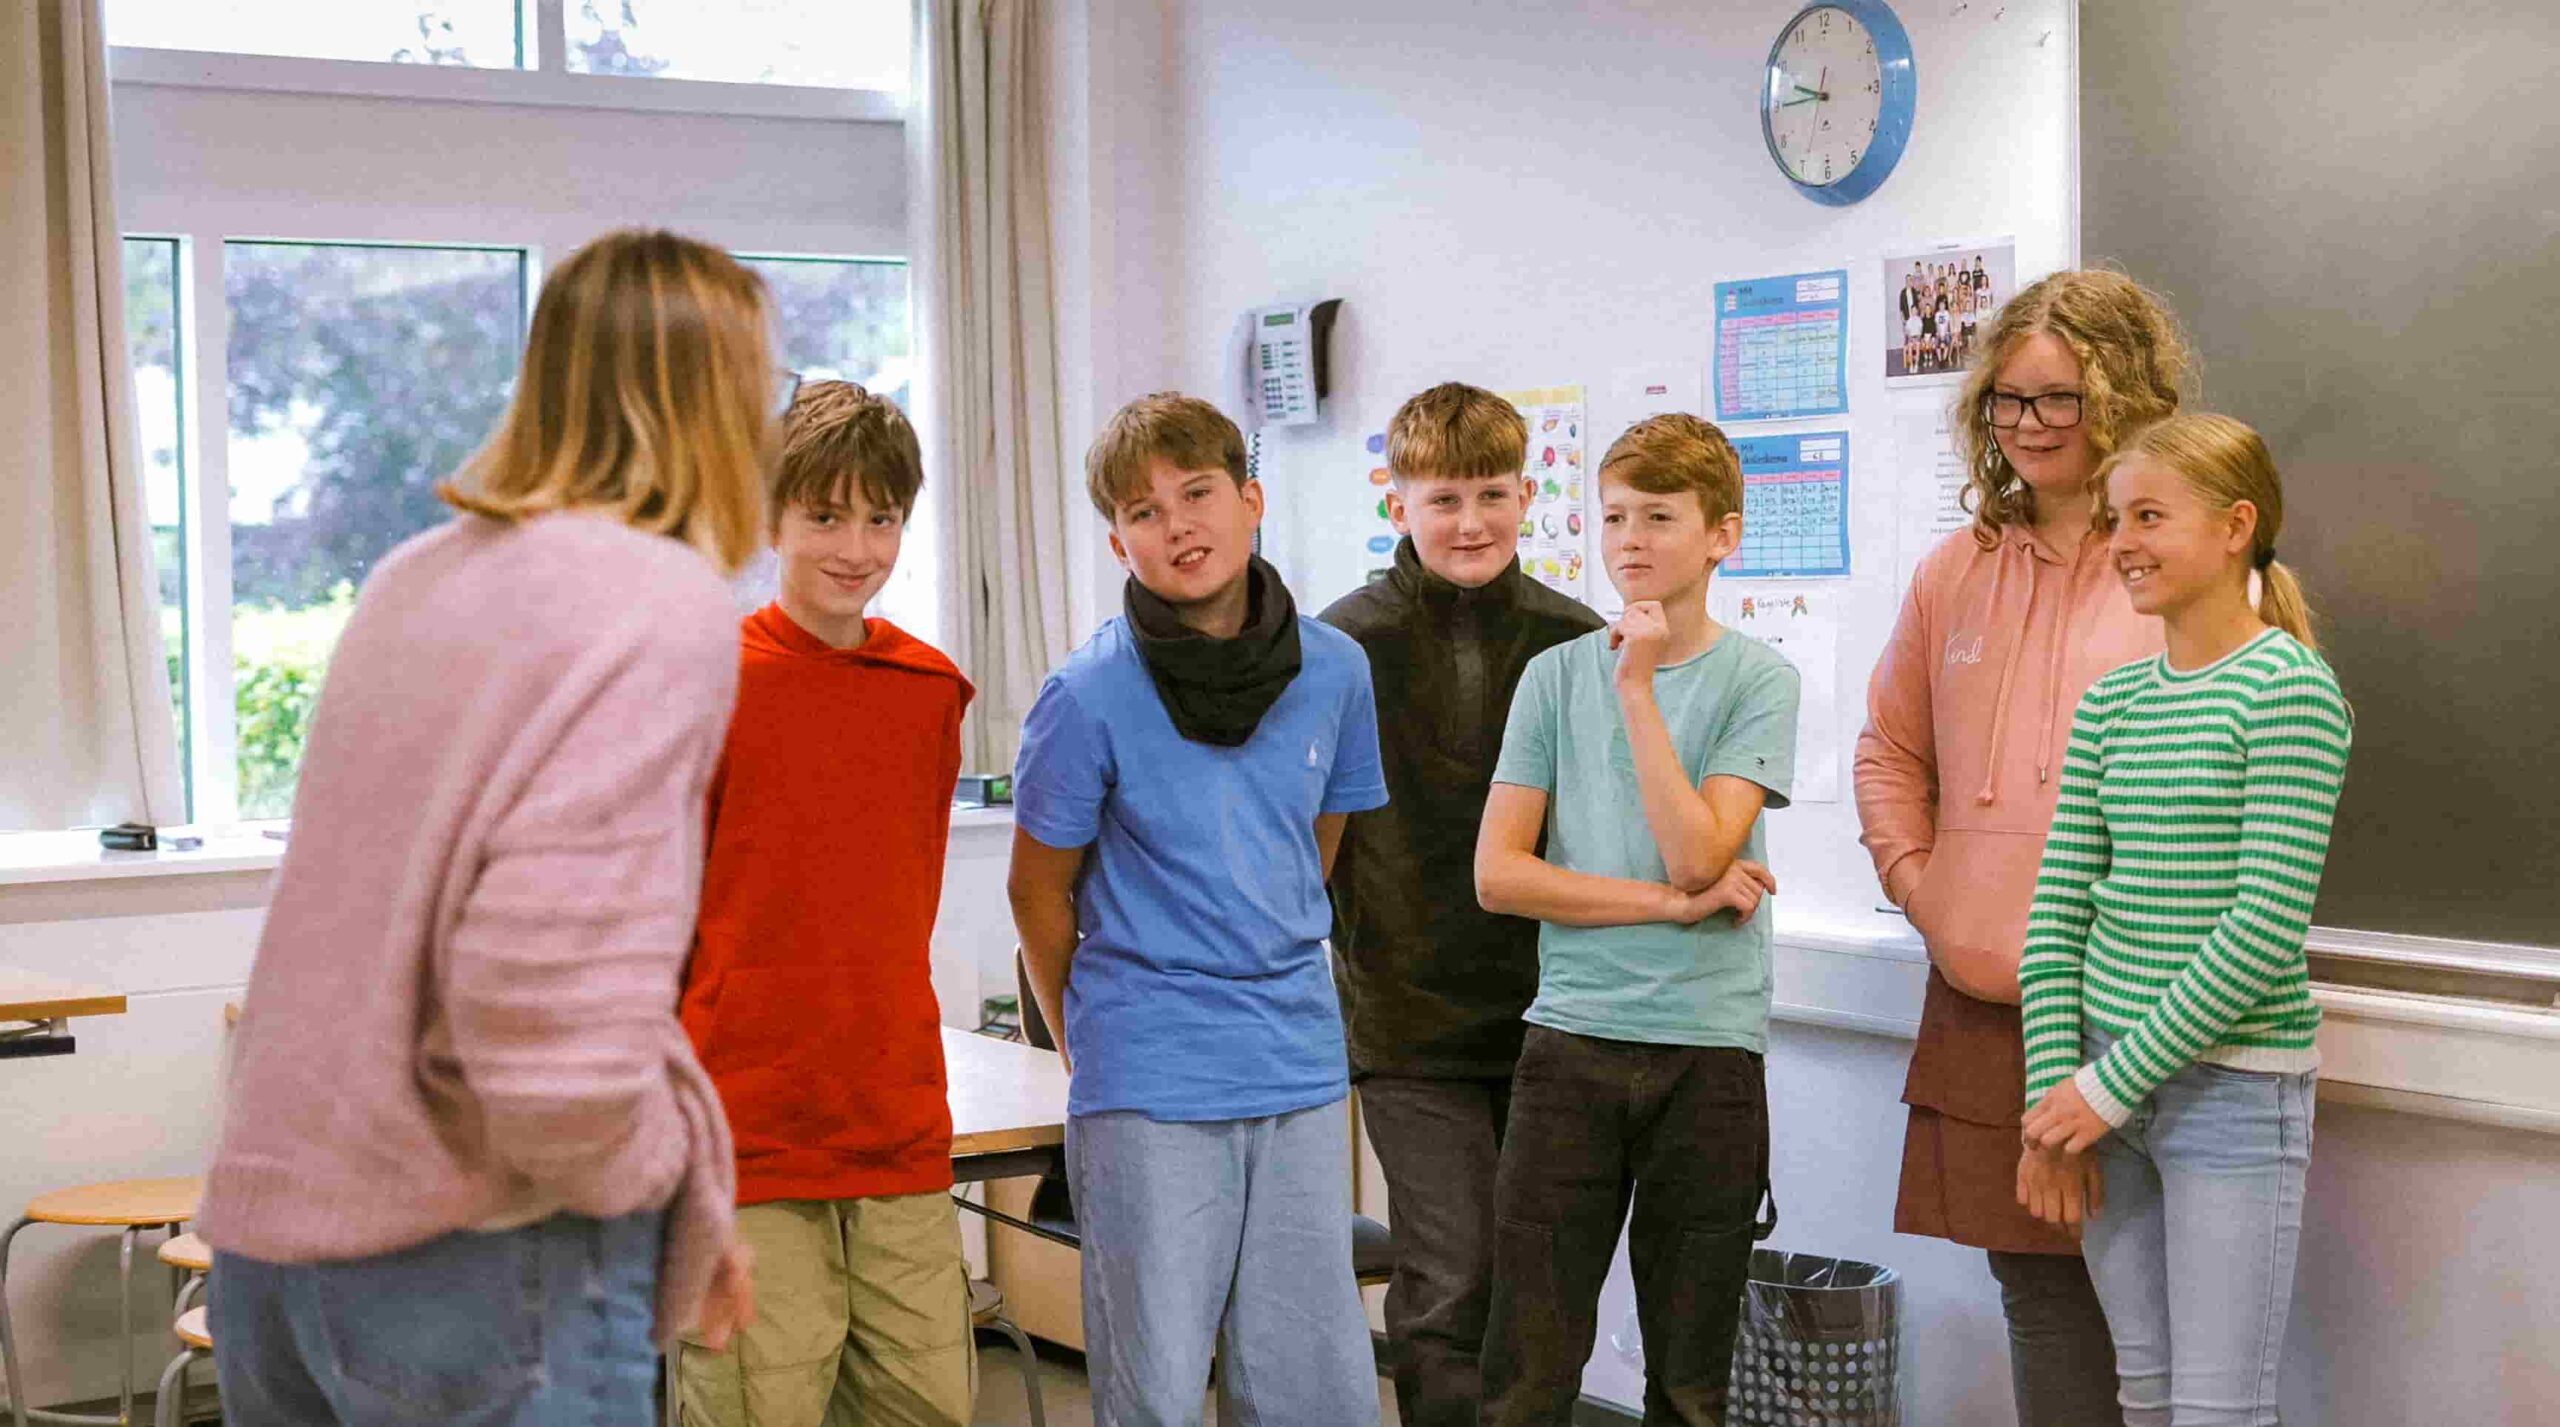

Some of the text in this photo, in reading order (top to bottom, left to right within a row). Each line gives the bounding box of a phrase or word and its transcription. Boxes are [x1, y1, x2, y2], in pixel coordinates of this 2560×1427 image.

[1818, 13, 1830, 27] 12
[1848, 20, 1853, 32] 1
[1794, 29, 1805, 44] 11
[1865, 40, 1872, 54] 2
[1873, 80, 1880, 94] 3
[1850, 150, 1857, 165] 5
[1800, 160, 1806, 174] 7
[1824, 166, 1831, 180] 6
